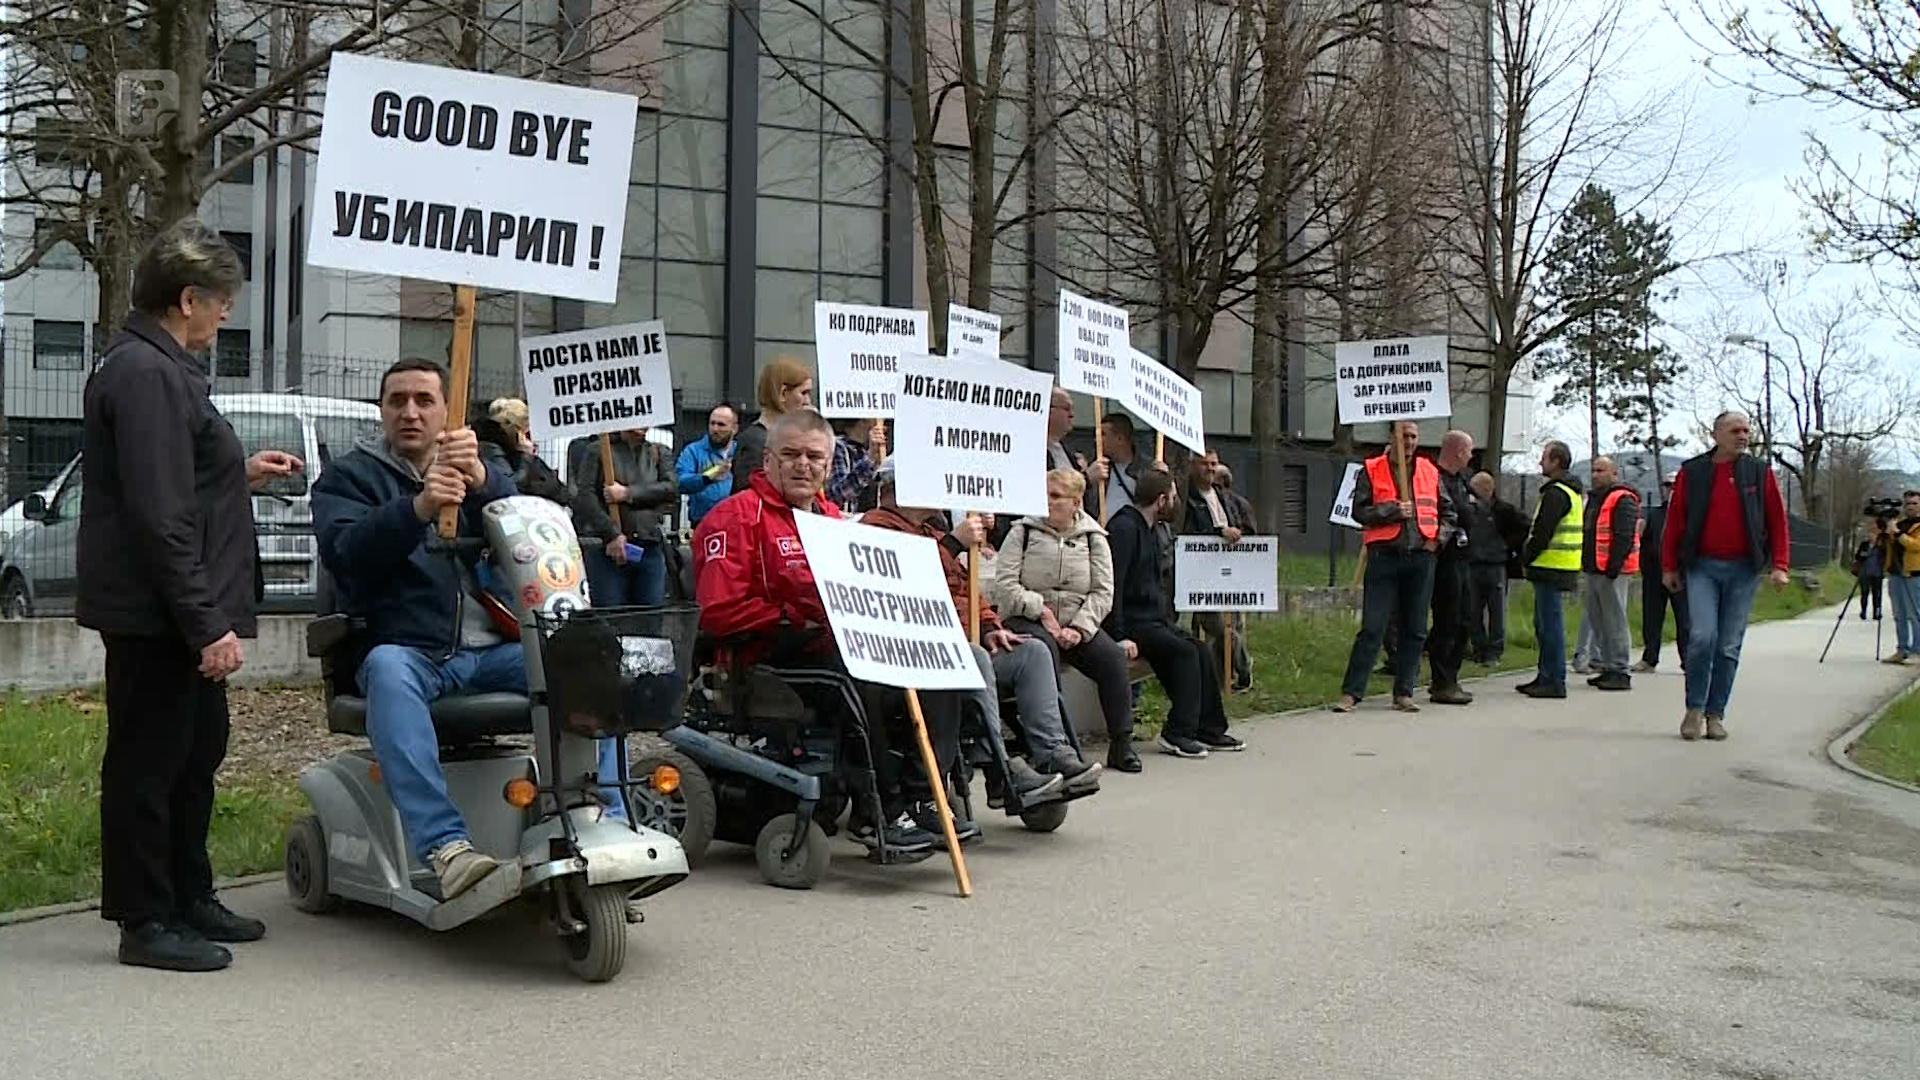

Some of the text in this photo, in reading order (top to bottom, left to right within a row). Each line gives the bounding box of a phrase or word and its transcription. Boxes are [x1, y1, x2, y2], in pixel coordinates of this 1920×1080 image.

[371, 90, 592, 165] GOOD BYE
[332, 191, 578, 267] УБИПАРИП
[829, 313, 915, 336] КО ПОДРЖАВА
[528, 333, 662, 372] ДОСТА НАМ ЈЕ
[1373, 344, 1410, 358] ПЛАТА
[554, 366, 642, 397] ПРАЗНИХ
[1340, 366, 1354, 379] СА
[826, 391, 833, 407] И
[837, 391, 864, 409] САМ
[867, 393, 878, 410] ЈЕ
[904, 374, 967, 404] ХОЋЕМО
[971, 385, 990, 405] НА
[1145, 382, 1161, 401] МИ
[1163, 394, 1186, 416] СМО
[1353, 381, 1432, 397] ЗАР ТРАЖИМО
[550, 395, 652, 427] ОБЕЋАЊА!
[934, 426, 1010, 454] А МОРАМО
[945, 473, 953, 493] У
[957, 475, 994, 497] ПАРК
[849, 541, 902, 580] СТОП
[1185, 543, 1268, 552] ЖЕЉКО УБИПАРИП
[824, 580, 954, 628] ДВОСТРУКИМ
[1189, 592, 1257, 606] КРИМИНАЛ
[842, 627, 955, 670] АРШИНИМА
